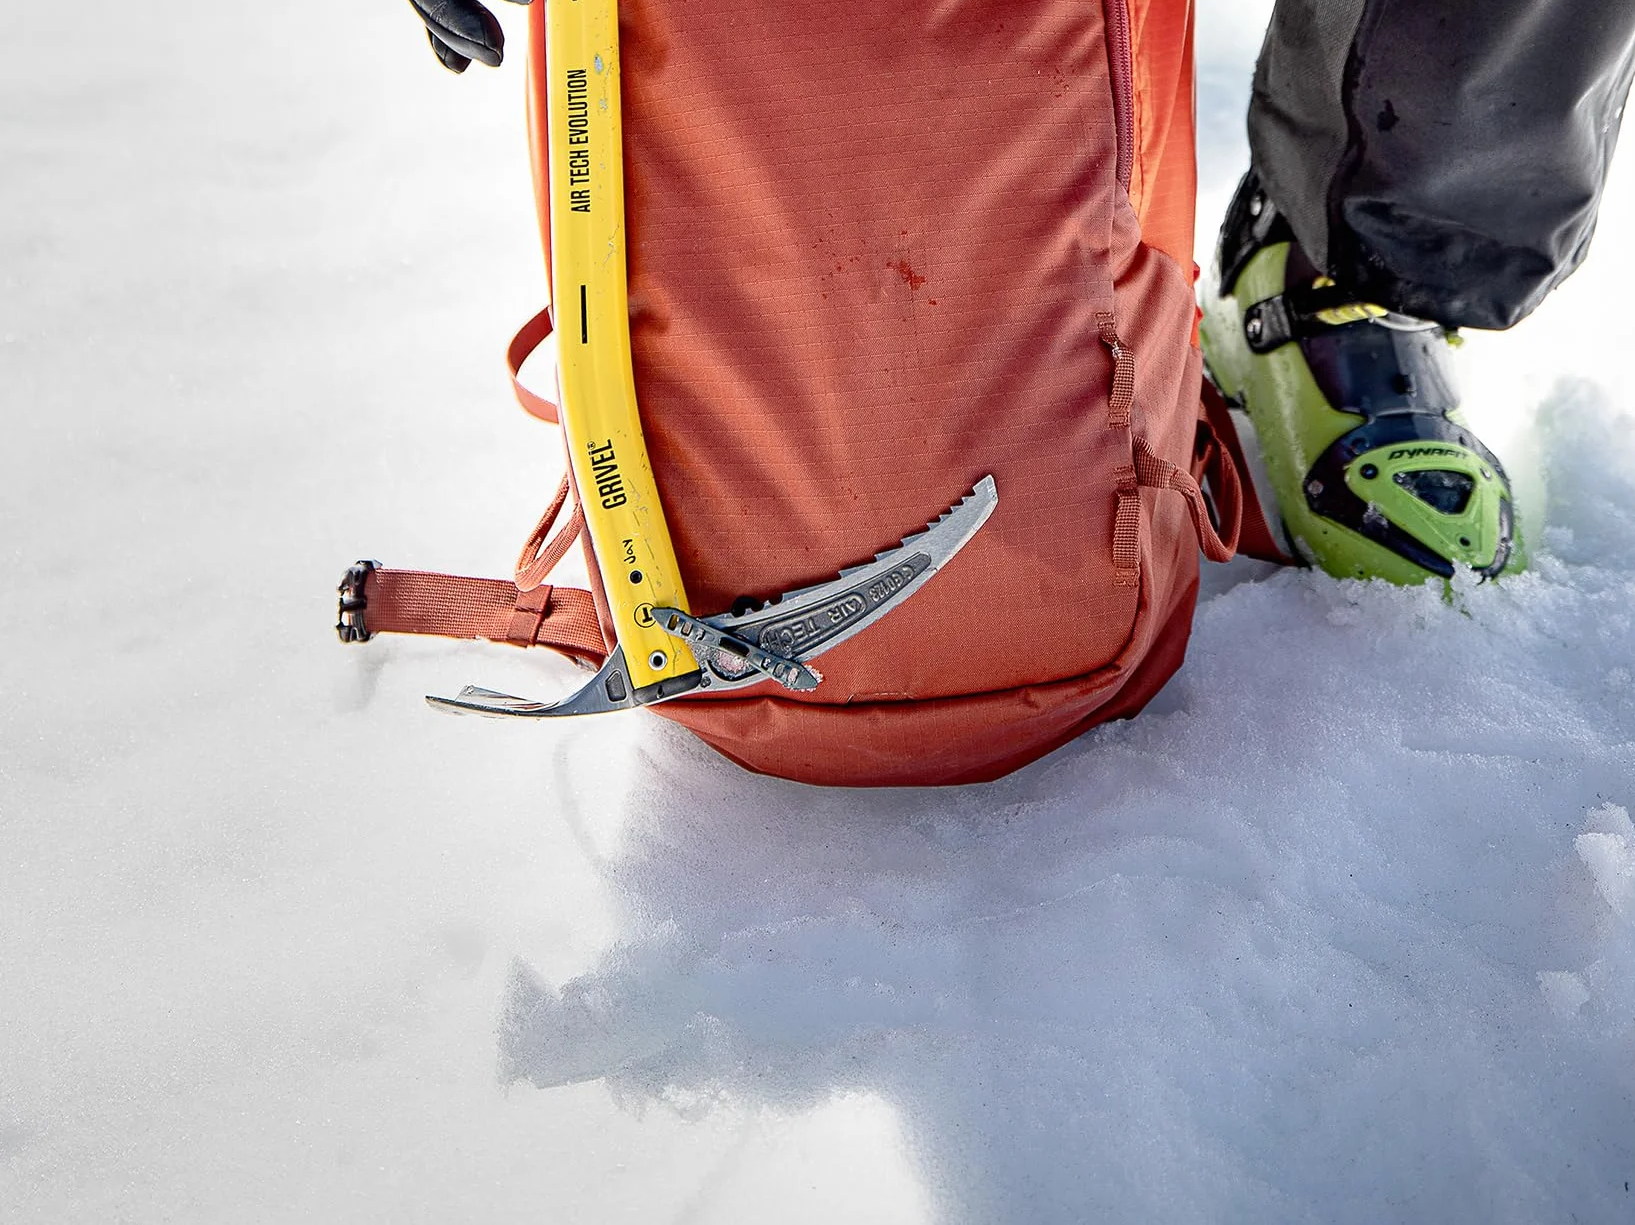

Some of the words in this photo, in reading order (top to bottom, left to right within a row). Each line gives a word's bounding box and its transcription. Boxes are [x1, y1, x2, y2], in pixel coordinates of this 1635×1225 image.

[567, 68, 589, 145] EVOLUTION
[569, 149, 590, 185] TECH
[570, 189, 591, 213] AIR
[1388, 447, 1469, 461] DYNAFIT
[826, 596, 859, 624] AIR
